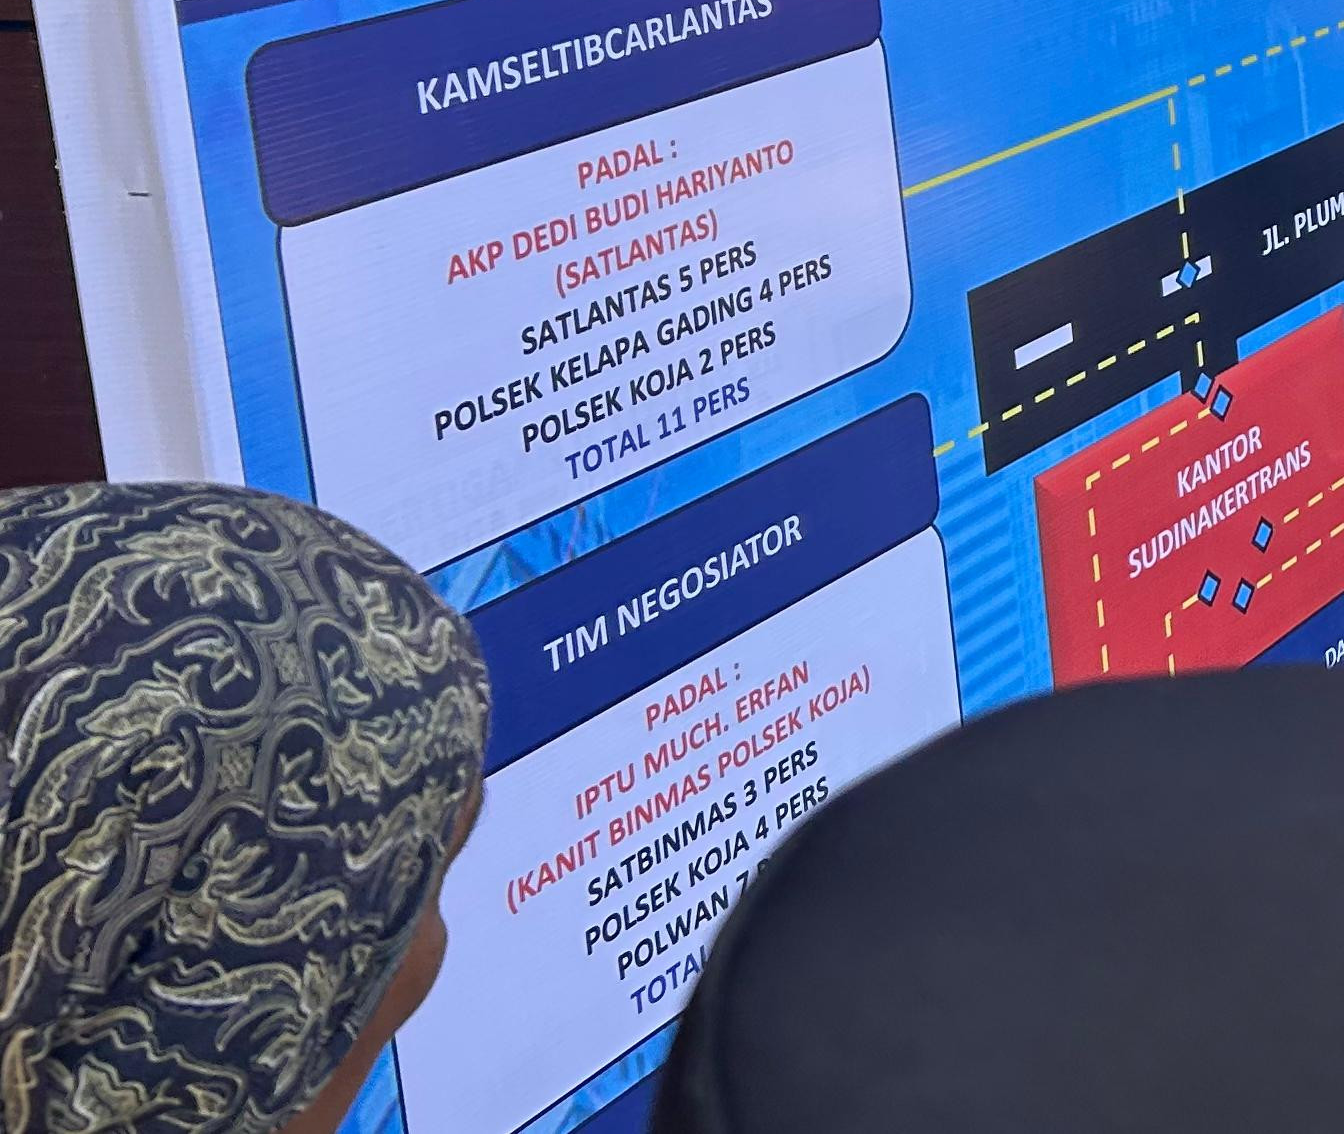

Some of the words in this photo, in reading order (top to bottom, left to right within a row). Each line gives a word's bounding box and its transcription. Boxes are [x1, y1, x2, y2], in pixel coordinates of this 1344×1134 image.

[447, 241, 505, 284] AKP
[512, 214, 578, 259] DEDI
[586, 189, 649, 235] BUDI
[656, 139, 794, 209] HARIYANTO
[577, 140, 663, 188] PADAL
[522, 276, 672, 355] SATLANTAS
[680, 266, 693, 292] 5
[700, 241, 757, 280] PERS
[556, 209, 719, 298] (SATLANTAS)
[1261, 224, 1290, 256] JL.
[434, 373, 543, 440] POLSEK
[551, 331, 650, 392] KELAPA
[657, 287, 753, 345] GADING
[759, 277, 773, 303] 4
[779, 254, 832, 296] PERS
[522, 387, 622, 452] POLSEK
[630, 358, 694, 406] KOJA
[700, 348, 714, 373] 2
[720, 321, 776, 365] PERS
[564, 425, 650, 480] TOTAL
[658, 408, 687, 438] 11
[694, 378, 750, 424] PERS
[1176, 425, 1263, 499] KANTOR
[1127, 440, 1312, 580] SUDINAKERTRANS
[543, 616, 607, 672] TIM
[618, 515, 804, 636] NEGOSIATOR
[576, 765, 635, 819] IPTU
[645, 721, 730, 775] MUCH.
[736, 661, 811, 723] ERFAN
[646, 667, 727, 730] PADAL
[507, 831, 600, 913] (KANIT
[609, 768, 711, 846] BINMAS
[718, 714, 803, 777] POLSEK
[809, 665, 871, 721] KOJA)
[588, 798, 737, 907] SATBINMAS
[744, 781, 757, 806] 3
[764, 742, 818, 794] PERS
[585, 872, 682, 955] POLSEK
[688, 831, 750, 887] KOJA
[755, 817, 769, 840] 4
[775, 776, 830, 826] PERS
[617, 885, 729, 981] POLWAN
